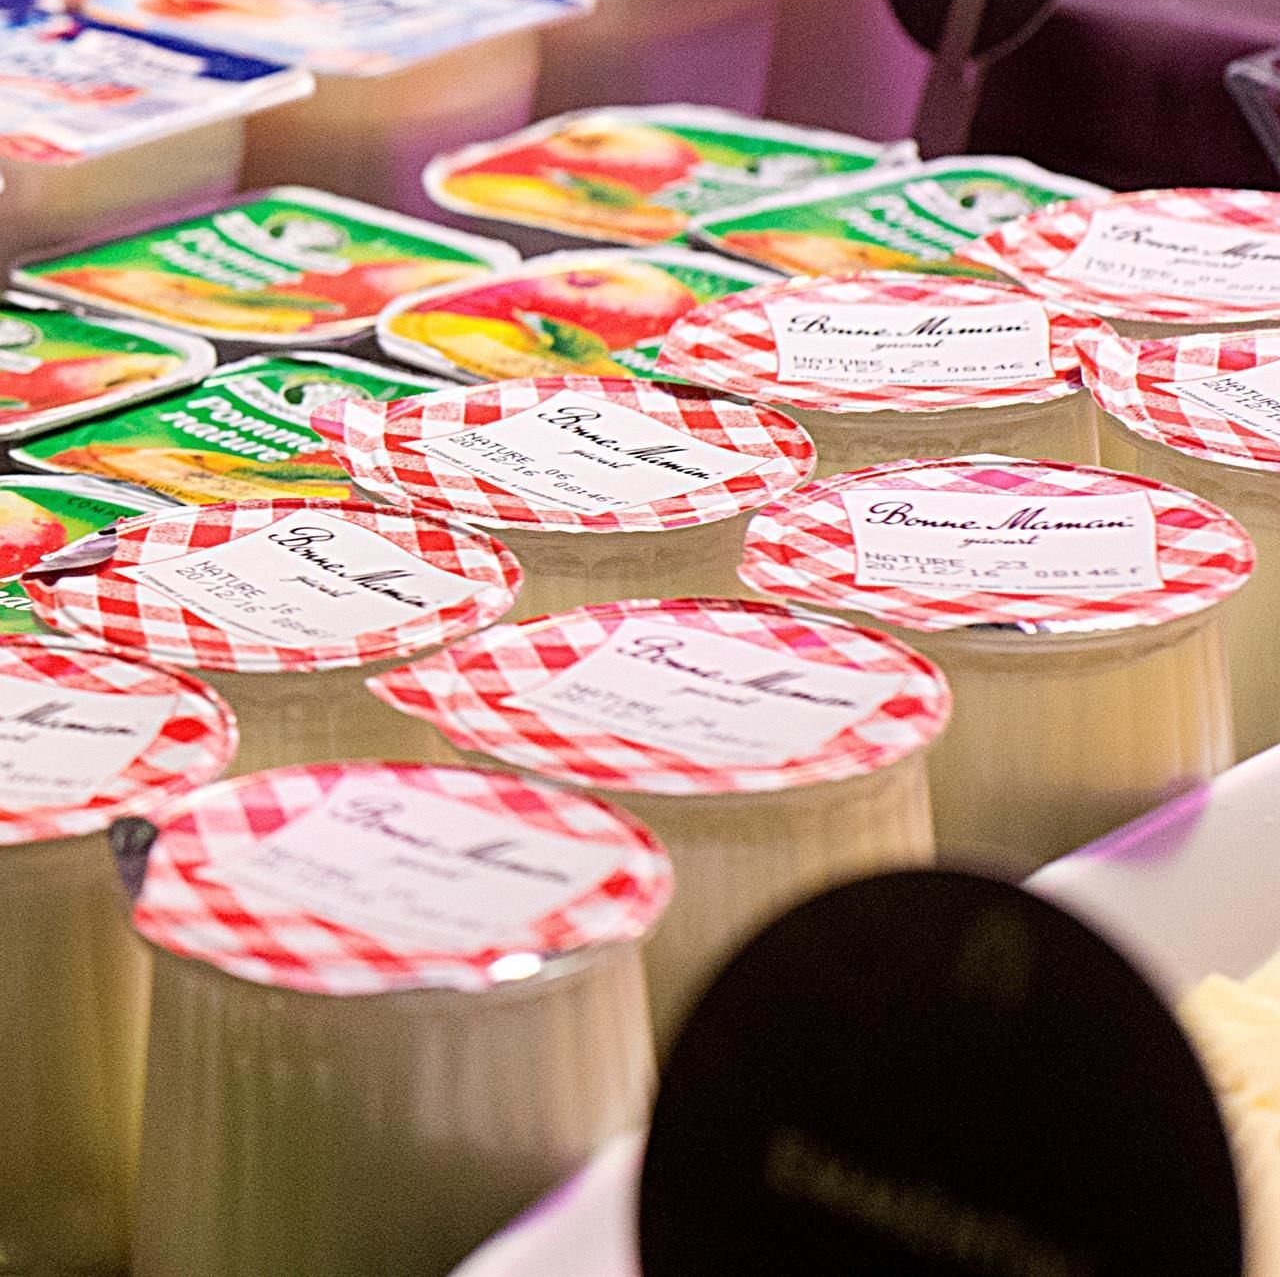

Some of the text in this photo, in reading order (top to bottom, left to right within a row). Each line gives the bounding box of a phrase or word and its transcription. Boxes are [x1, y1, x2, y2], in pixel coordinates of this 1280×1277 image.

[787, 313, 1026, 336] Bonne Maman
[160, 411, 290, 462] nature
[187, 395, 329, 453] Pomme
[538, 407, 614, 447] Bonne
[614, 445, 714, 481] Maman
[448, 436, 541, 478] 20/12/16
[463, 432, 575, 481] NATURE 06
[865, 501, 1130, 530] Bonne Maman
[864, 551, 965, 568] NATURE
[957, 534, 1042, 548] yaourt
[195, 560, 267, 599] NATURE
[268, 527, 344, 576] Bonne
[339, 569, 427, 609] Maman
[175, 567, 265, 614] 20/12/16
